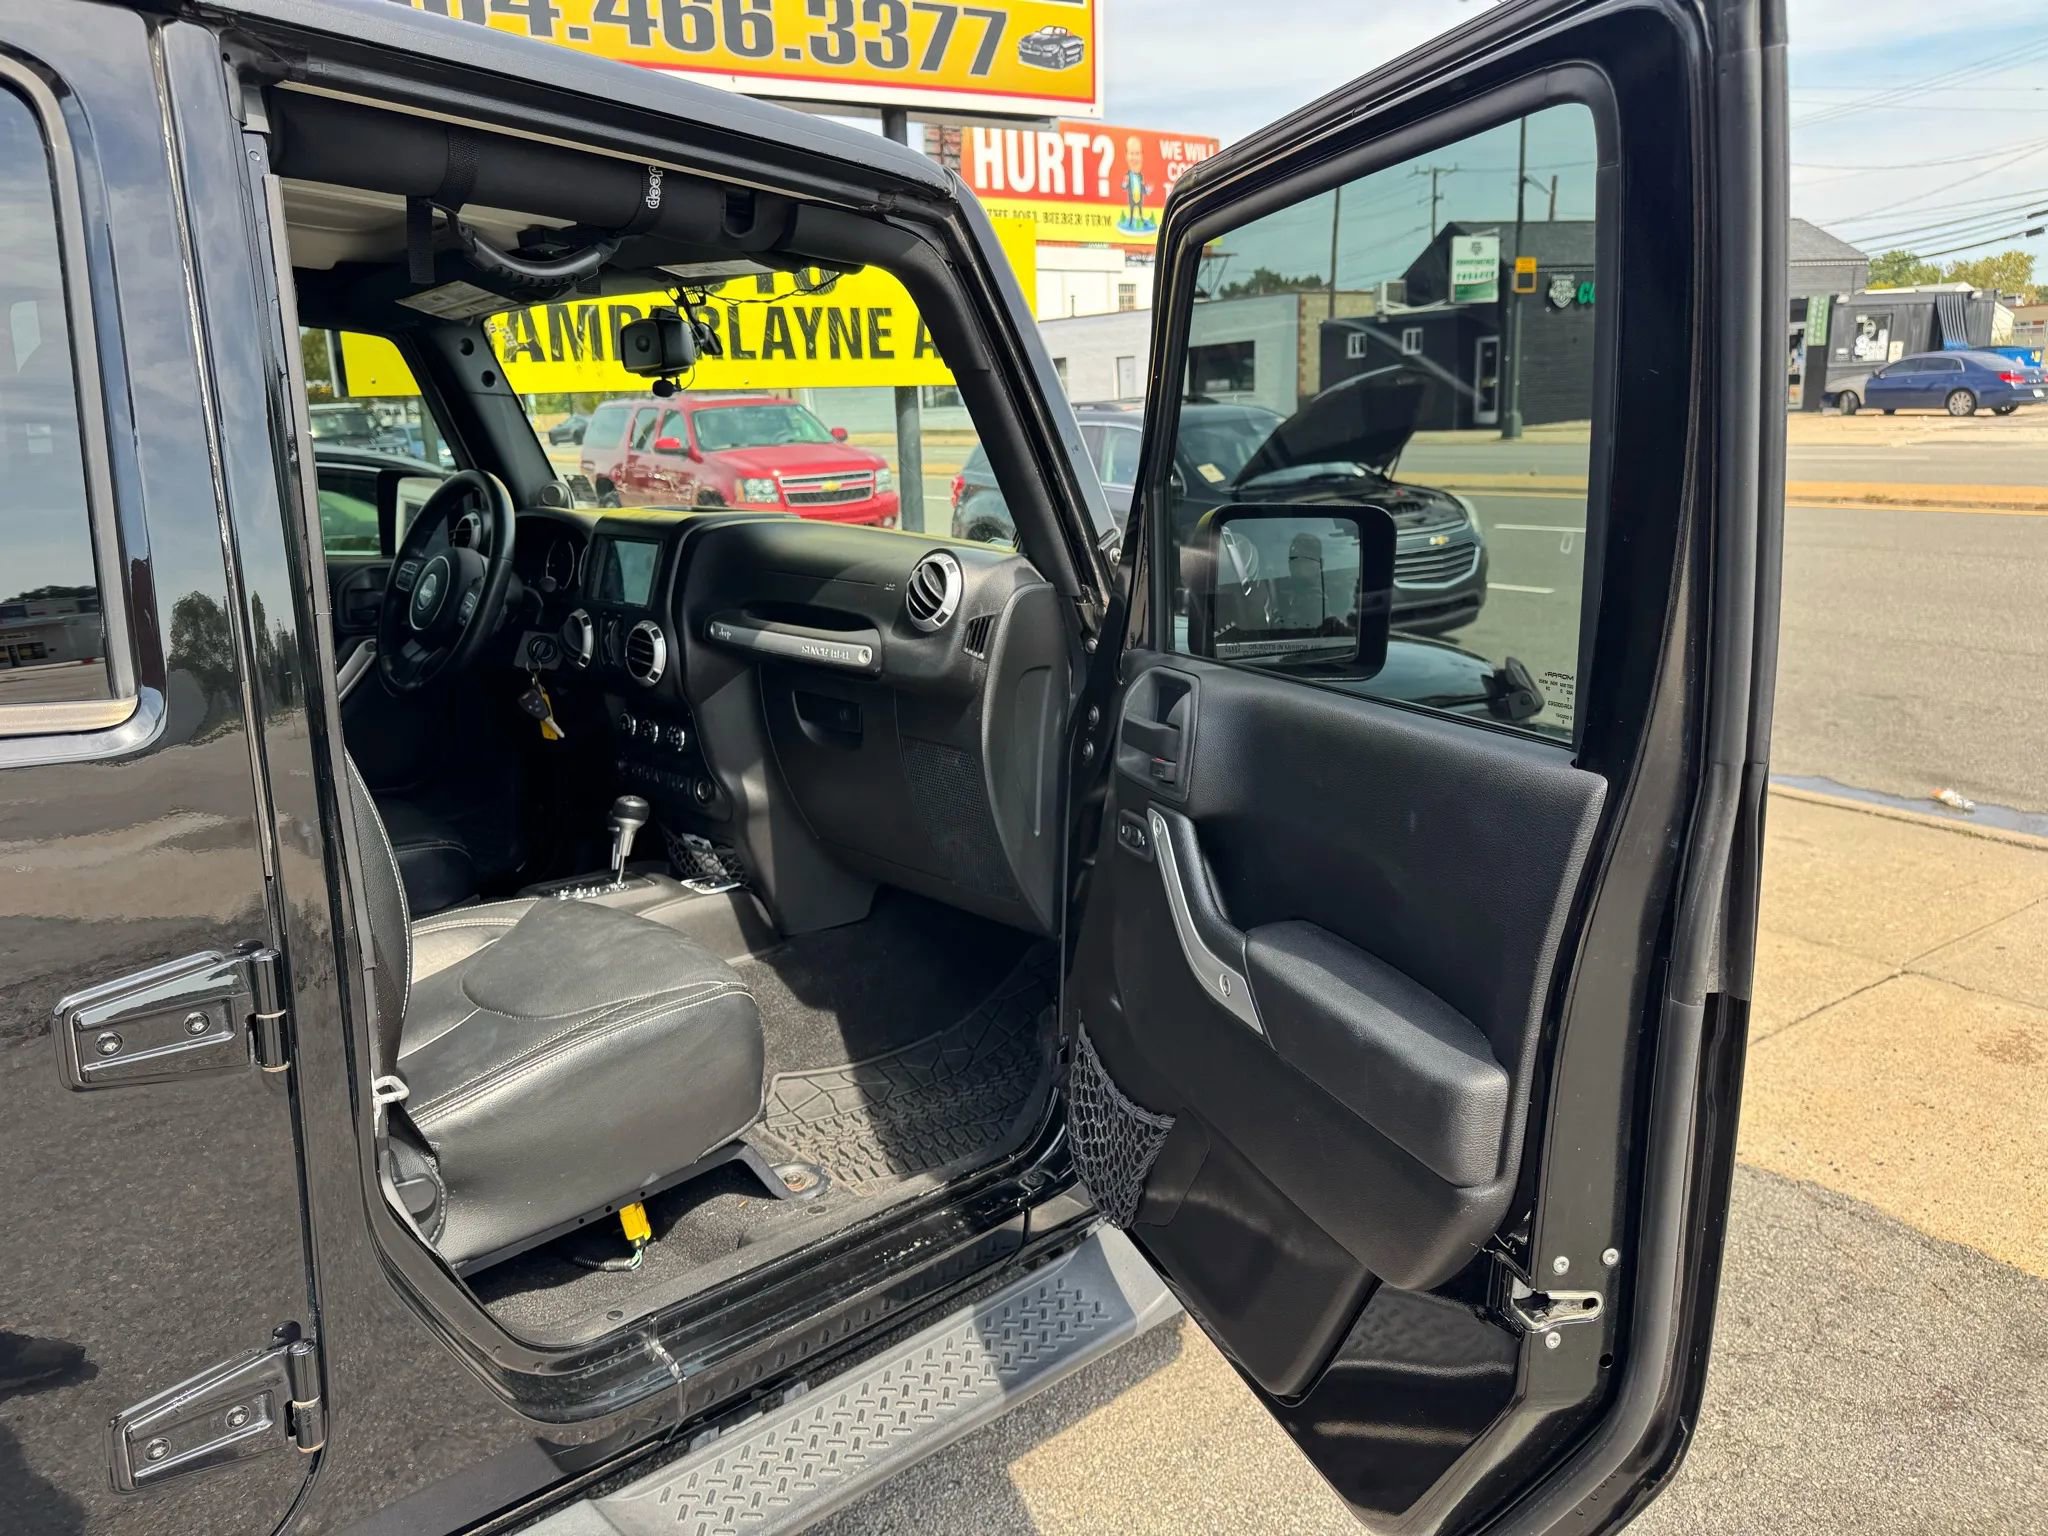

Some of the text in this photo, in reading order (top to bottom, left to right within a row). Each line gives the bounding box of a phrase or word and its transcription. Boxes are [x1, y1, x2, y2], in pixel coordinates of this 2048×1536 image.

[972, 127, 1116, 198] HURT?
[1159, 139, 1183, 161] WE
[646, 165, 663, 209] Jeep
